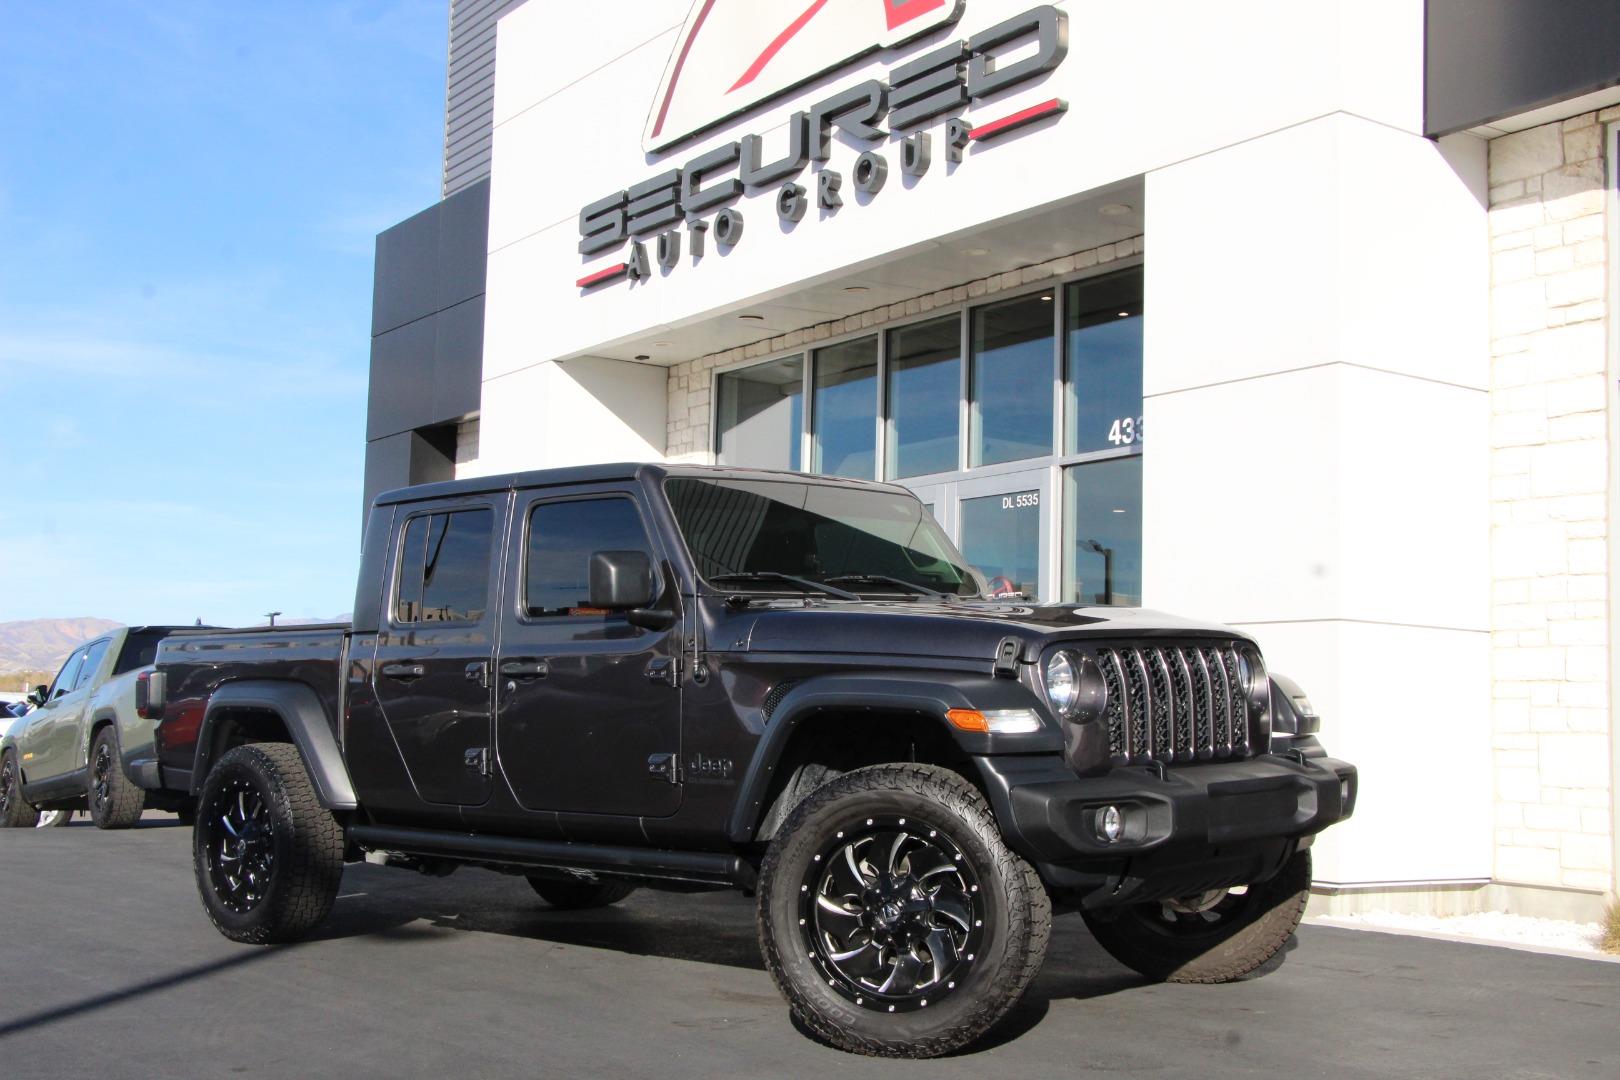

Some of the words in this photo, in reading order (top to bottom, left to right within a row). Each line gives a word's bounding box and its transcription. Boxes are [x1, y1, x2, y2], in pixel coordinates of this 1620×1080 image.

[578, 4, 1068, 255] SECURED
[627, 207, 744, 281] AUTO
[776, 117, 974, 222] GROUP
[1002, 496, 1015, 509] DL
[1016, 493, 1039, 508] 5535
[690, 752, 734, 778] Jeep
